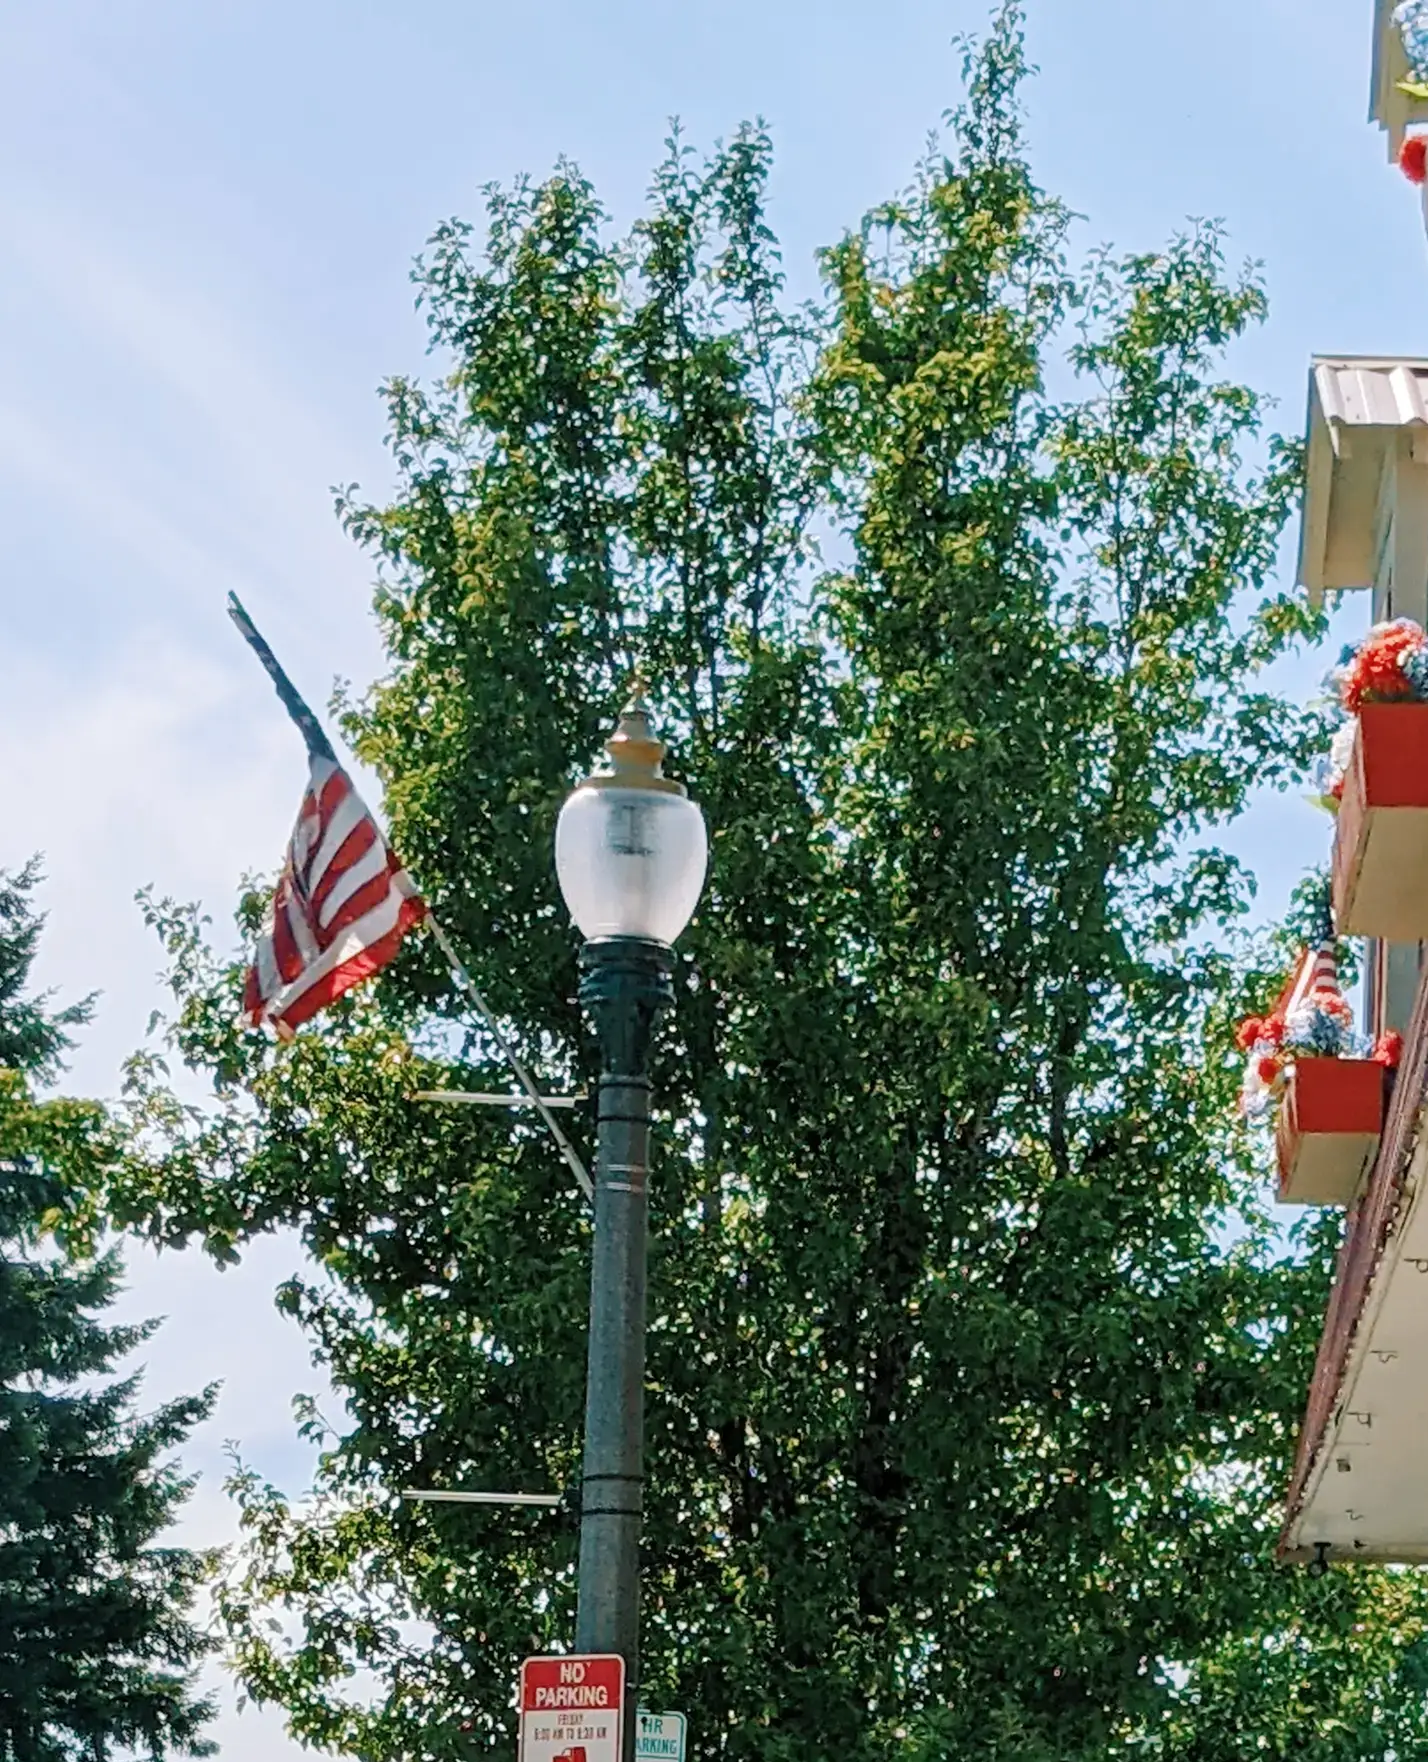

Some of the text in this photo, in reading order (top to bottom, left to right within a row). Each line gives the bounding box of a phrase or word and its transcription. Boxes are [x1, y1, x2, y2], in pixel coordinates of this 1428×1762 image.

[560, 1662, 586, 1684] NO
[535, 1685, 608, 1708] PARKING
[635, 1737, 677, 1754] ARKING
